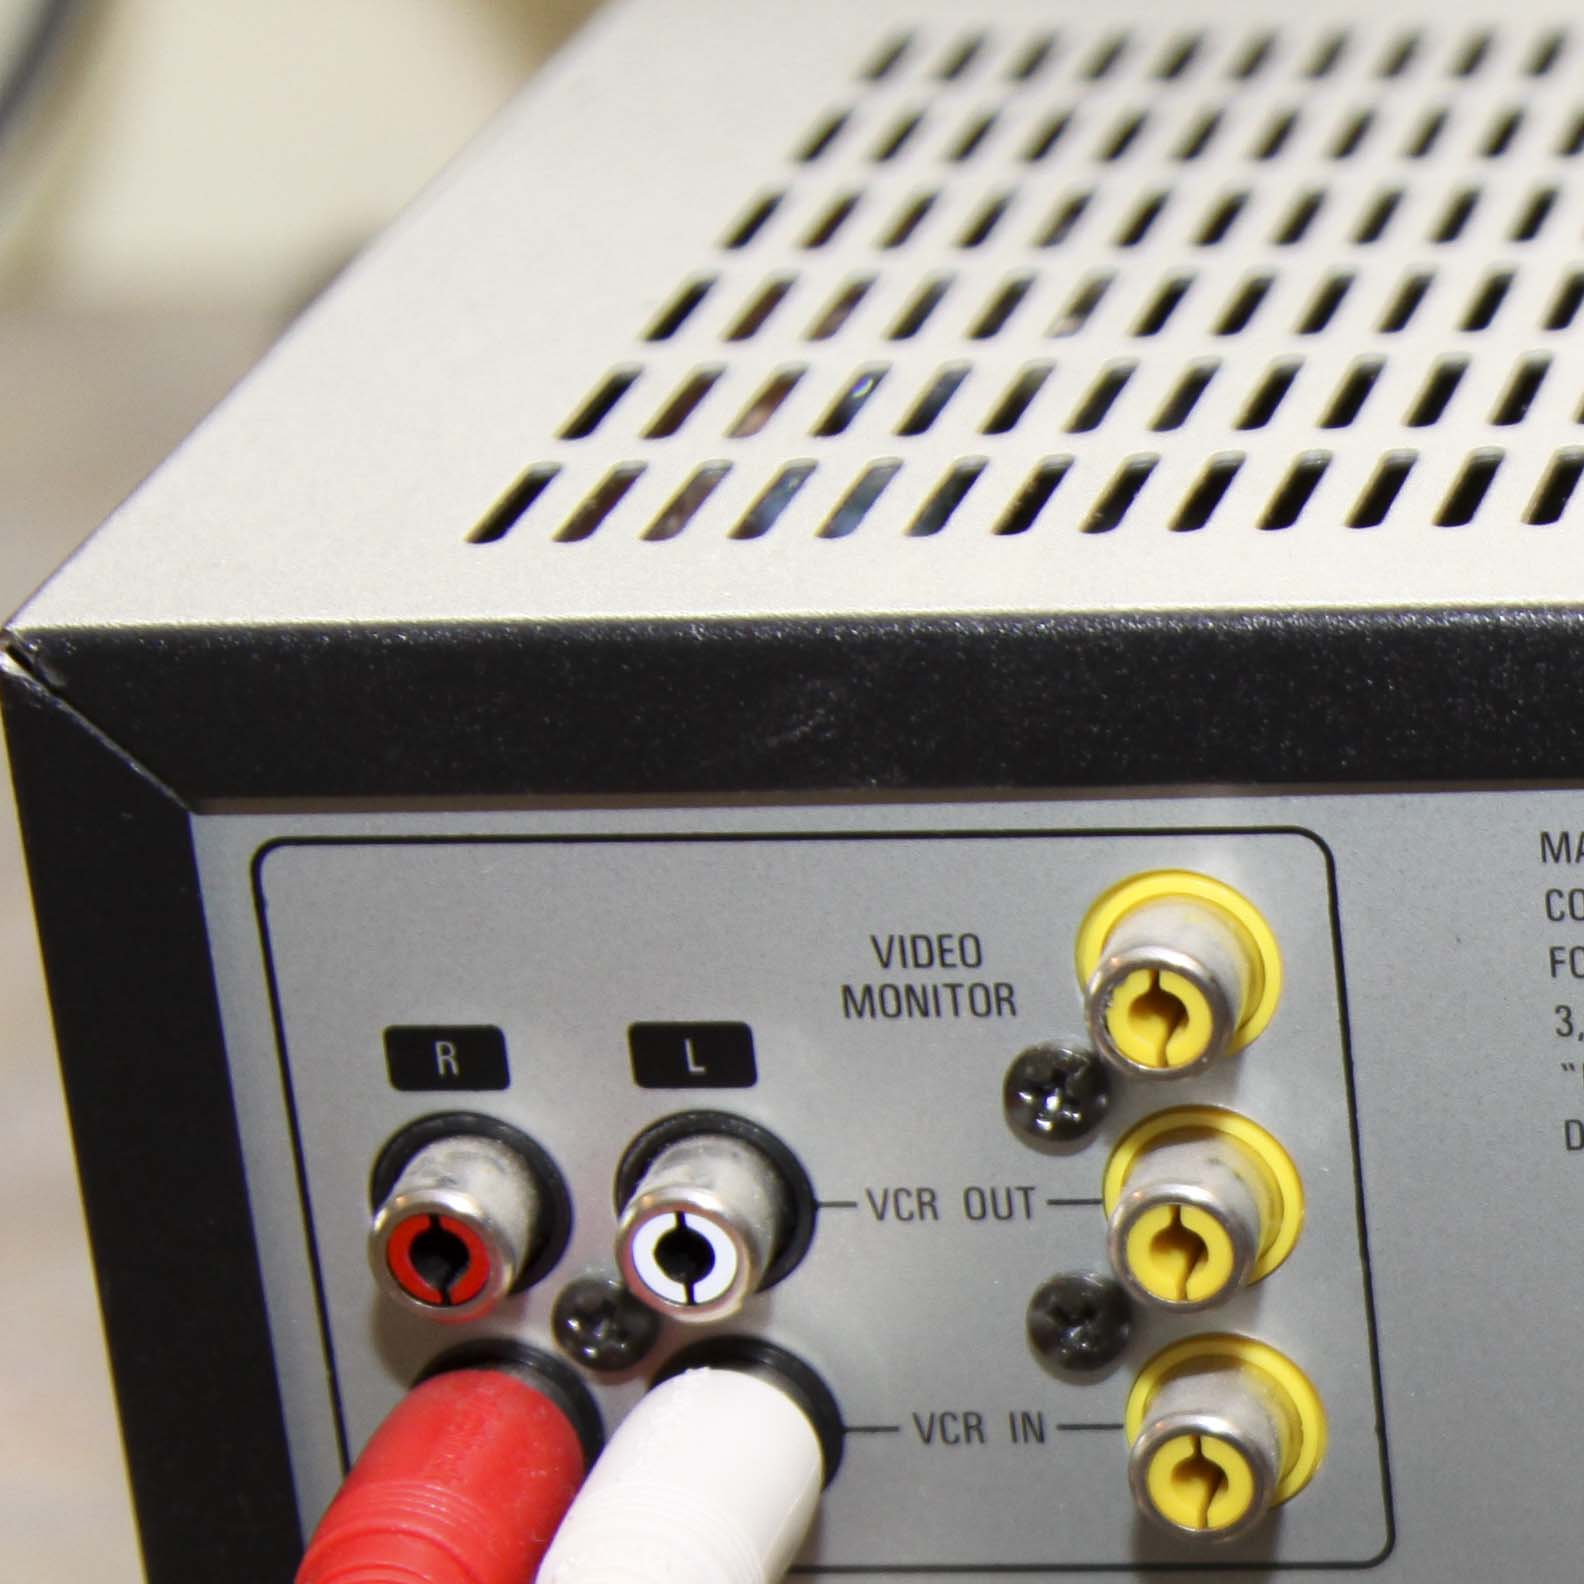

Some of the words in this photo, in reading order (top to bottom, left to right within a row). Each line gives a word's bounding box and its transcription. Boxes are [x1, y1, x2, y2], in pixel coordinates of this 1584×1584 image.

[871, 933, 982, 969] VIDEO
[842, 983, 1016, 1018] MONITOR
[435, 1041, 458, 1075] R
[685, 1039, 705, 1073] L
[866, 1187, 939, 1222] VCR
[964, 1186, 1035, 1221] OUT
[913, 1412, 986, 1445] VCR
[1009, 1411, 1045, 1444] IN
